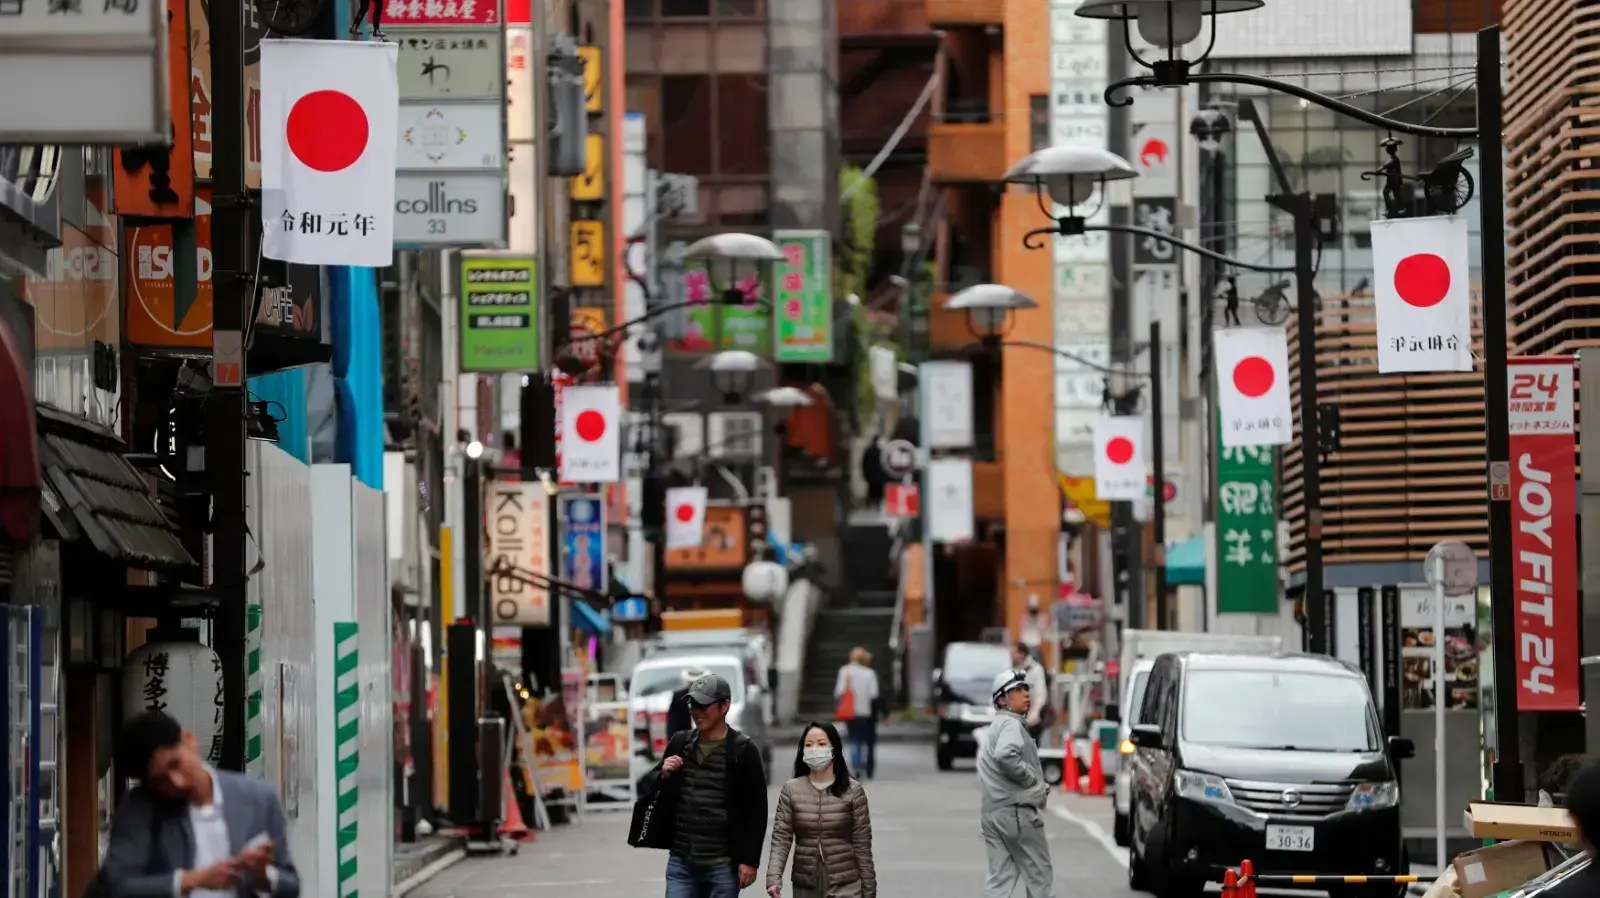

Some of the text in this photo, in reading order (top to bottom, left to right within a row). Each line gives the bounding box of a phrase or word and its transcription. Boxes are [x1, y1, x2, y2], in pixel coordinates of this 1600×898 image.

[396, 182, 478, 214] collins
[281, 208, 376, 236] 令和元年
[427, 219, 447, 234] 33
[1510, 373, 1560, 399] 24
[1510, 402, 1557, 412] 時間営業
[637, 810, 652, 842] DELUCA
[1539, 830, 1573, 839] HITACHI
[1277, 835, 1312, 849] 30-36
